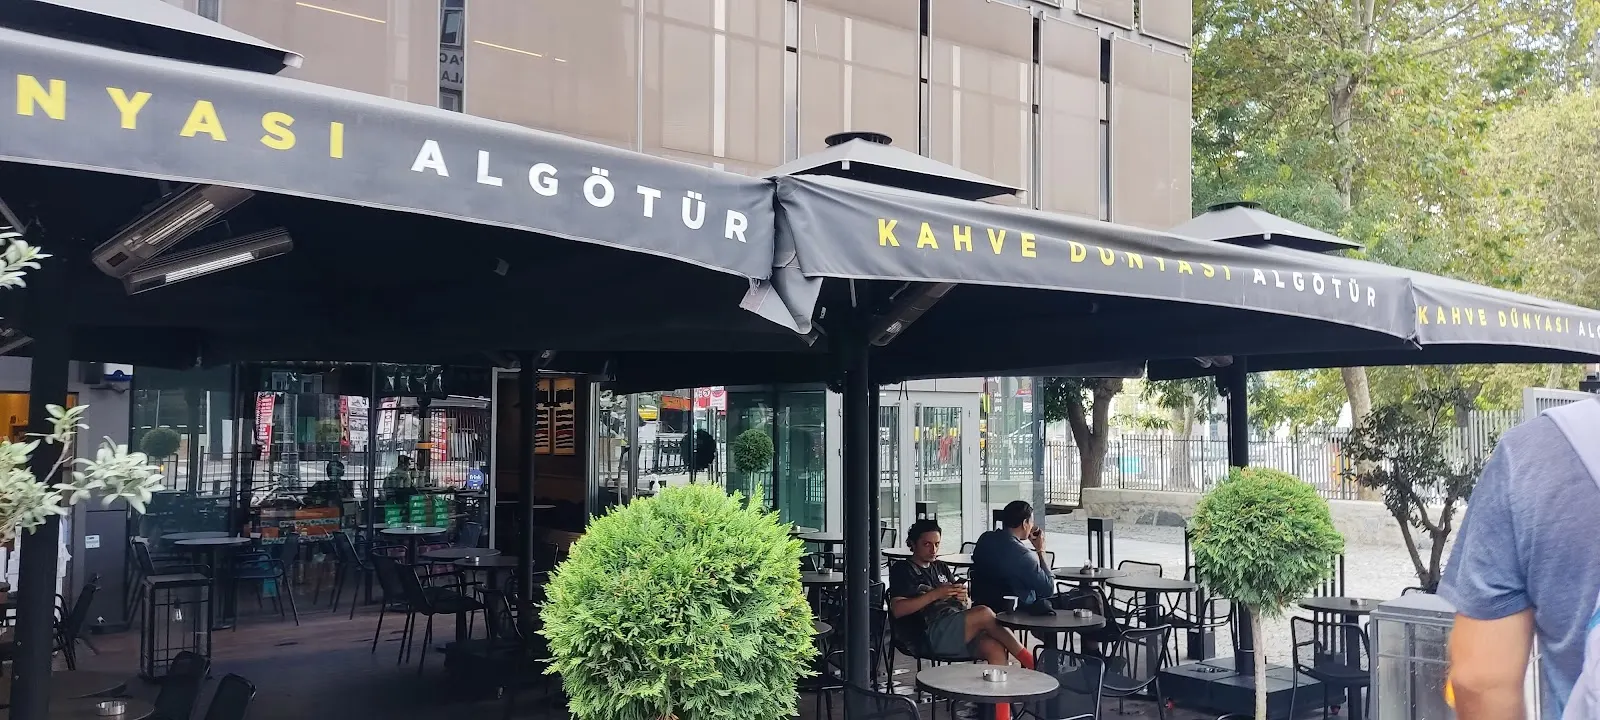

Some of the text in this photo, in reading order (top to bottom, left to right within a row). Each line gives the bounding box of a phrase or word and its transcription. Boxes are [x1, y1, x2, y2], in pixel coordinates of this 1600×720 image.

[16, 73, 749, 244] NYASI ALGÖTÜR
[877, 218, 1037, 258] KAHVE
[1252, 267, 1377, 307] ALGÖTÜR
[1417, 305, 1488, 326] KAHVE
[1498, 307, 1570, 334] DÜNYASI
